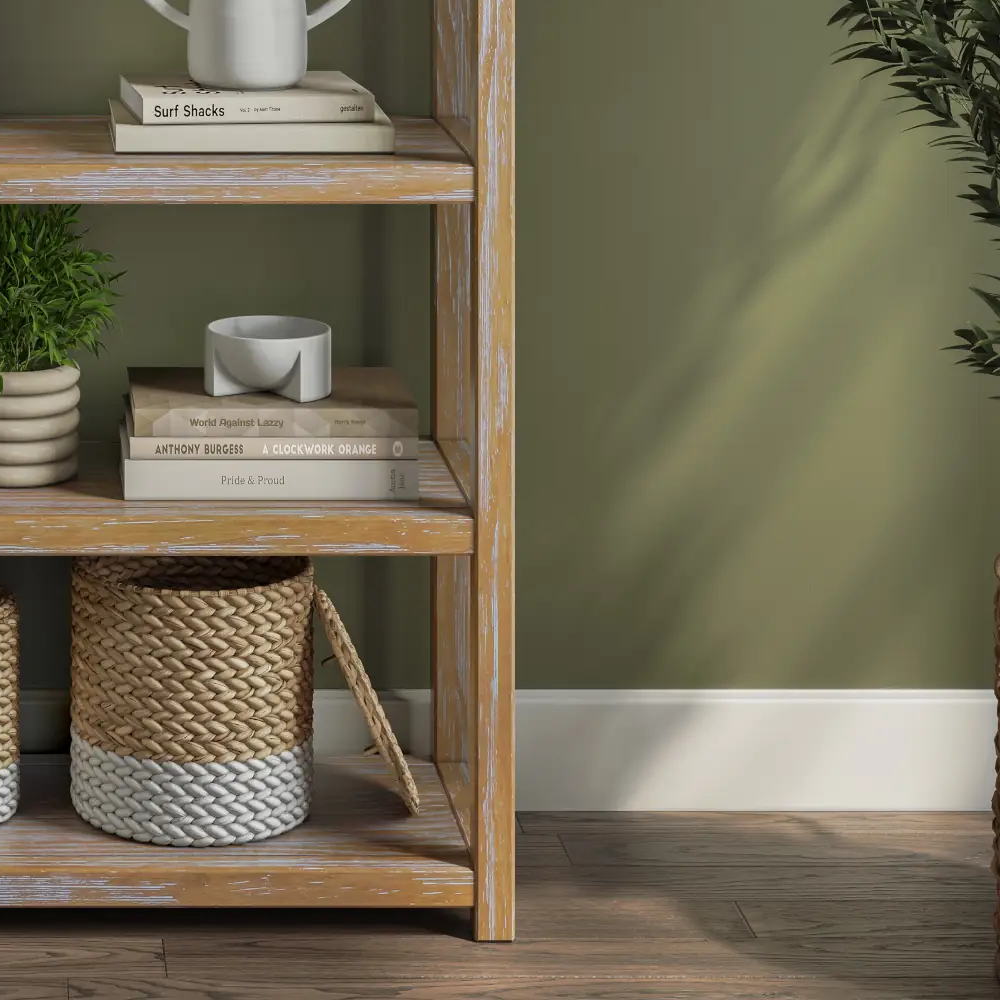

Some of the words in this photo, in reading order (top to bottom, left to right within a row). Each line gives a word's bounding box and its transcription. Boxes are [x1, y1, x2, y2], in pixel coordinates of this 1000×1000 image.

[154, 105, 178, 118] Surf
[184, 104, 224, 117] Shacks
[340, 105, 364, 113] gestalten
[189, 418, 218, 428] World
[219, 418, 255, 428] Against
[257, 418, 284, 428] Lazzy
[155, 444, 200, 454] ANTHONY
[204, 444, 244, 454] BURGESS
[262, 444, 270, 454] A
[272, 444, 335, 454] CLOCKWORK
[338, 444, 377, 454] ORANGE
[221, 476, 246, 484] Pride
[248, 476, 256, 484] &
[258, 476, 285, 484] Proud
